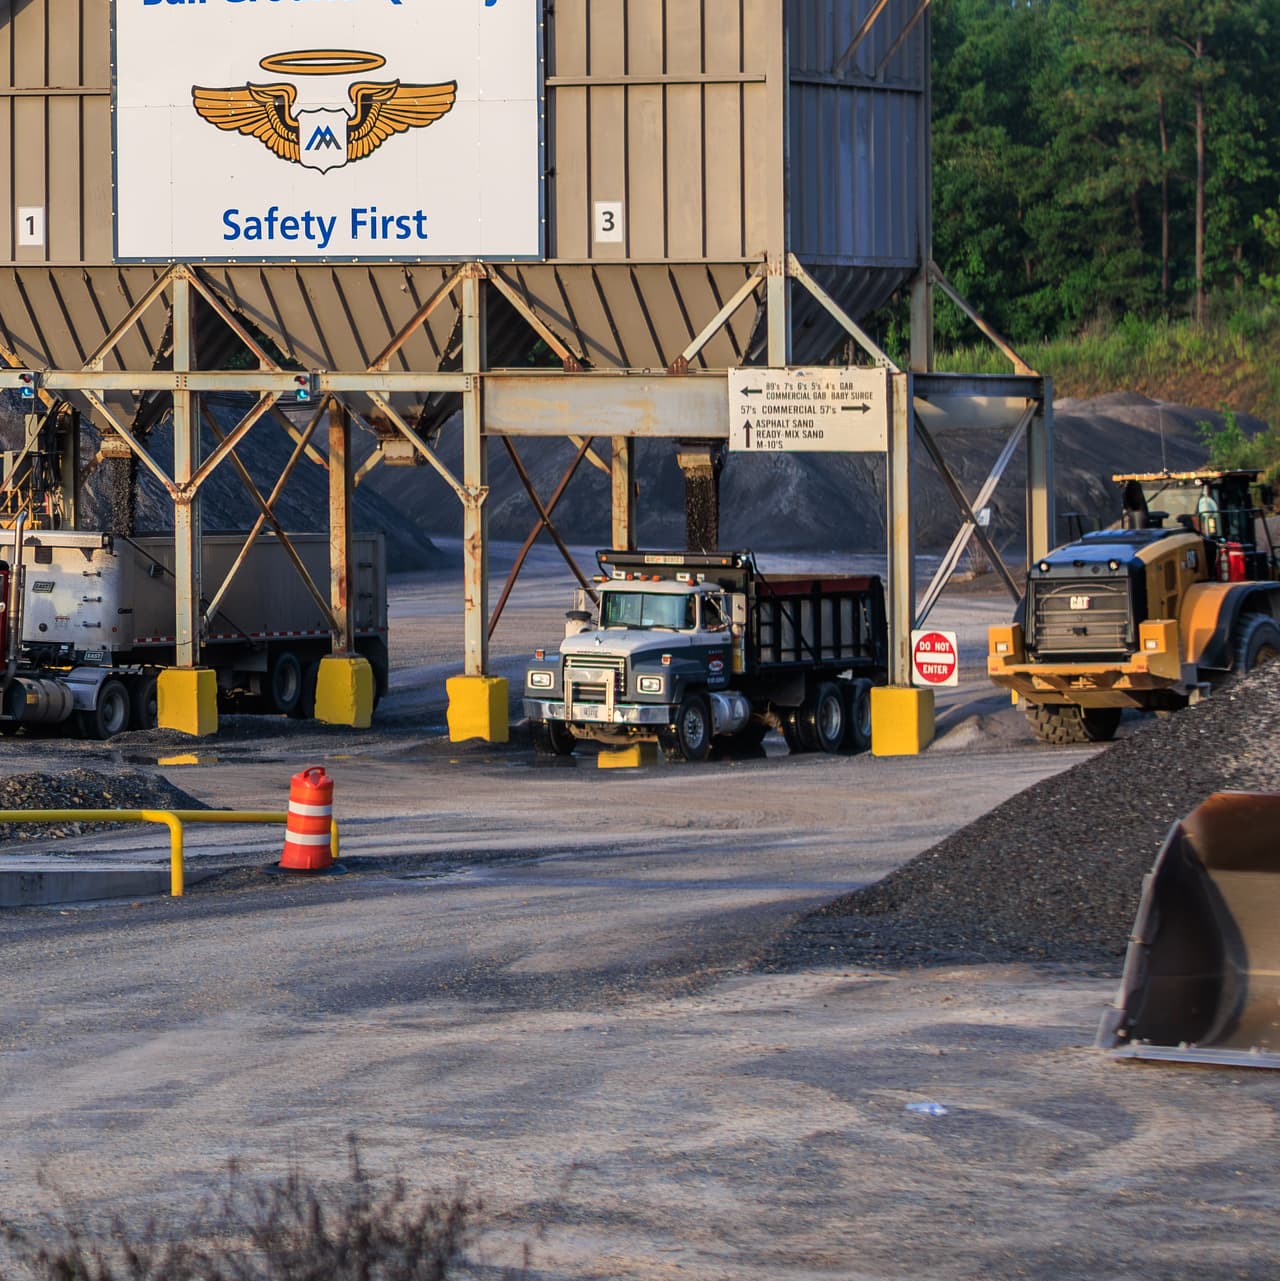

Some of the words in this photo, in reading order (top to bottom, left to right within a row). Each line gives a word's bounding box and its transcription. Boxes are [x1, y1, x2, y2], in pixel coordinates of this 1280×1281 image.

[26, 215, 34, 235] 1
[601, 211, 615, 231] 3
[223, 206, 337, 248] Safety
[351, 207, 428, 240] First
[784, 382, 793, 391] 7's
[811, 382, 821, 391] 5's
[825, 382, 835, 391] 4's
[766, 391, 811, 401] COMMERCIAL
[831, 391, 849, 401] BABY
[850, 391, 873, 401] SURGE
[740, 405, 757, 415] 57's
[761, 405, 817, 415] COMMERCIAL
[819, 405, 837, 415] 57's
[756, 419, 790, 429] ASPHALT
[792, 419, 814, 429] SAND
[802, 429, 824, 439] SAND
[1070, 596, 1090, 609] CAT
[919, 640, 931, 651] DO
[934, 641, 949, 652] NOT
[922, 664, 948, 674] ENTER
